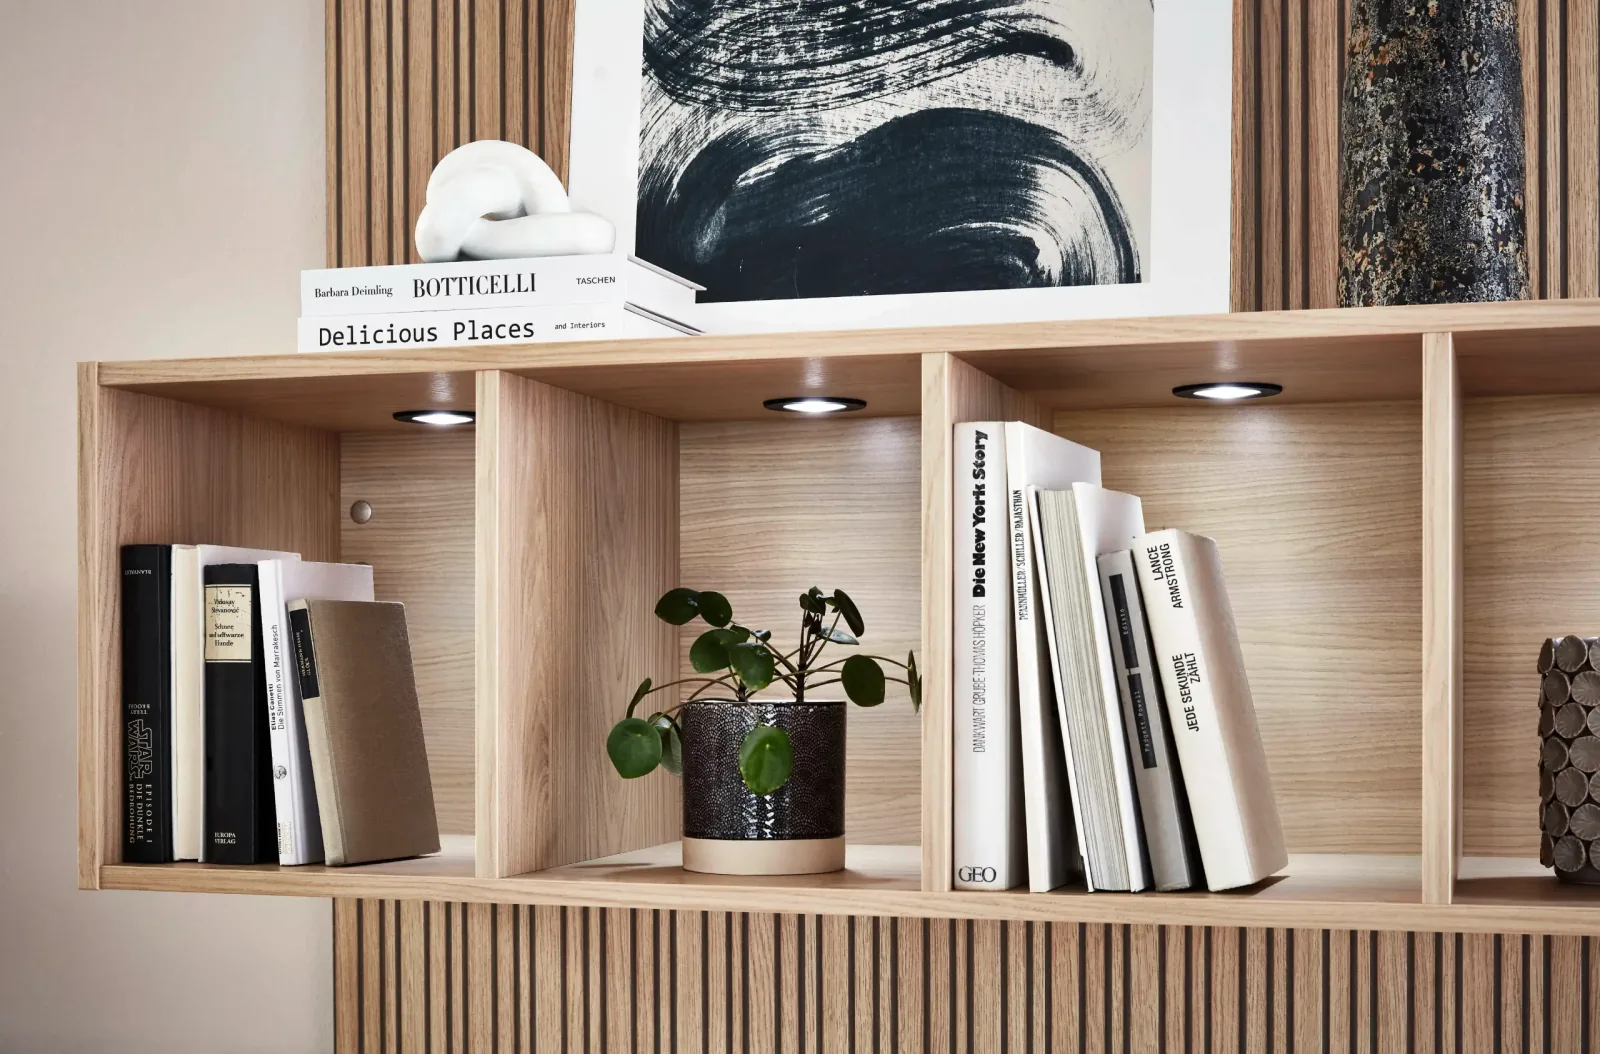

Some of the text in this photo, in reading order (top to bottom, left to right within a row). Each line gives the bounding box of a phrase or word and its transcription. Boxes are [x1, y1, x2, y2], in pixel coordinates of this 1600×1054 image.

[314, 284, 393, 298] Barbara Deimling
[412, 272, 537, 299] BOTTICELLI
[575, 276, 616, 285] TASCHEN
[318, 319, 535, 346] Delicious Places
[554, 321, 606, 330] and Interiors
[972, 430, 988, 597] Die New York Story
[1146, 544, 1164, 581] LANCE
[1159, 543, 1184, 609] ARMSTRONG
[971, 604, 986, 639] HÖPKER
[1119, 608, 1129, 635] Edisto
[271, 624, 280, 668] Marrakesch
[1184, 652, 1201, 684] ZÄHLT
[275, 684, 284, 717] Stimmen
[1172, 653, 1200, 732] JEDE SEKUNDE
[277, 718, 285, 730] Die
[972, 708, 986, 753] DANKWART
[1135, 690, 1149, 752] Padgett Powell
[128, 719, 139, 779] WARS
[138, 718, 153, 779] STAR
[136, 802, 144, 841] DUNKLE
[958, 865, 997, 883] GEO
